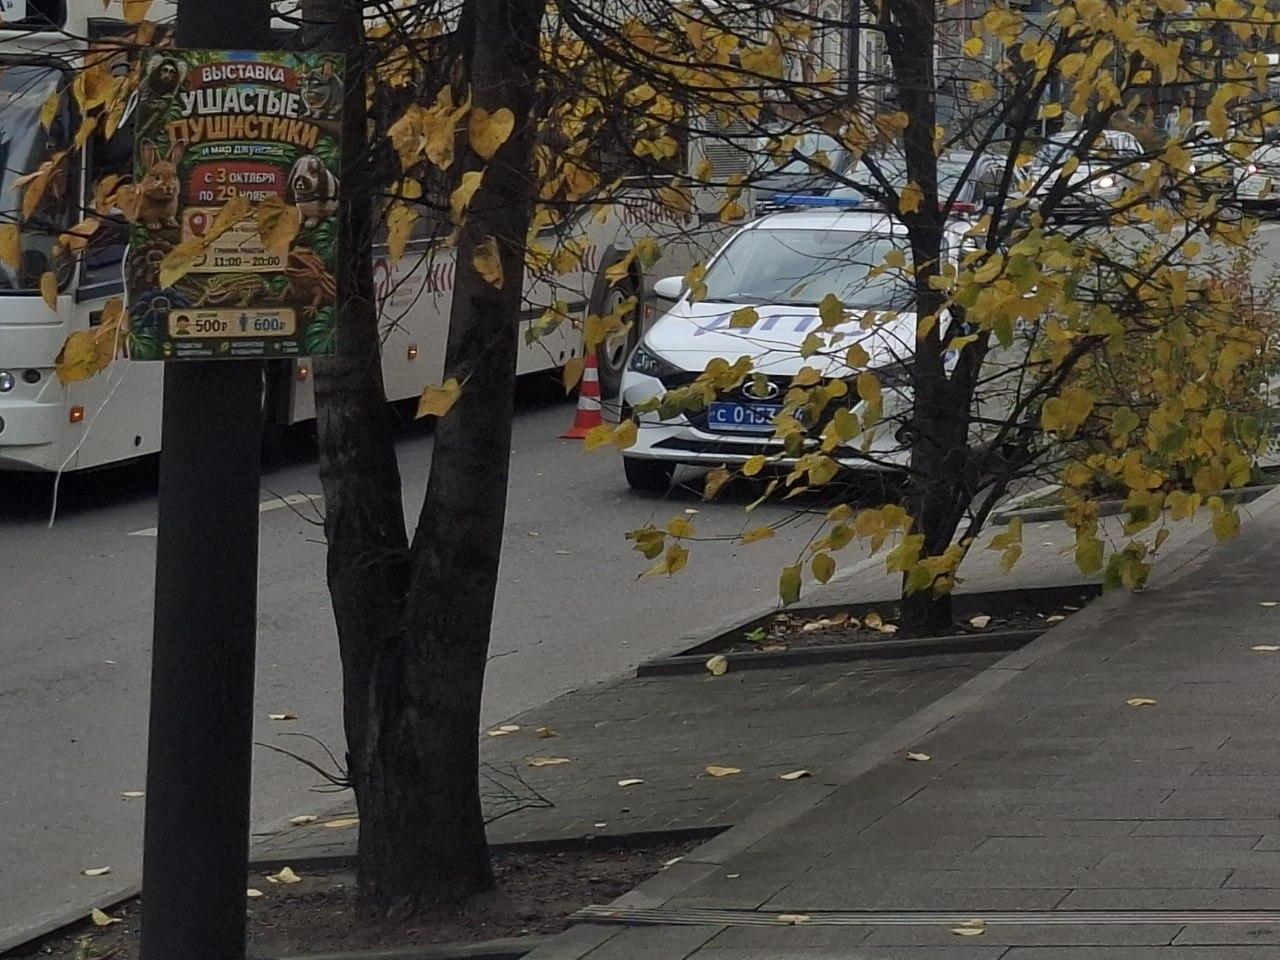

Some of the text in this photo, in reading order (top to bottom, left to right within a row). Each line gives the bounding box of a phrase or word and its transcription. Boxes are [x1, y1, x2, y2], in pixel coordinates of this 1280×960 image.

[202, 64, 286, 82] ВЫСТАВКА
[181, 88, 301, 118] УШАСТЫЕ
[166, 115, 320, 148] ПУШИСТИКИ
[216, 168, 227, 183] 3
[229, 172, 276, 184] ОКТЯБРЯ
[199, 190, 214, 201] ПО
[217, 186, 237, 201] 29
